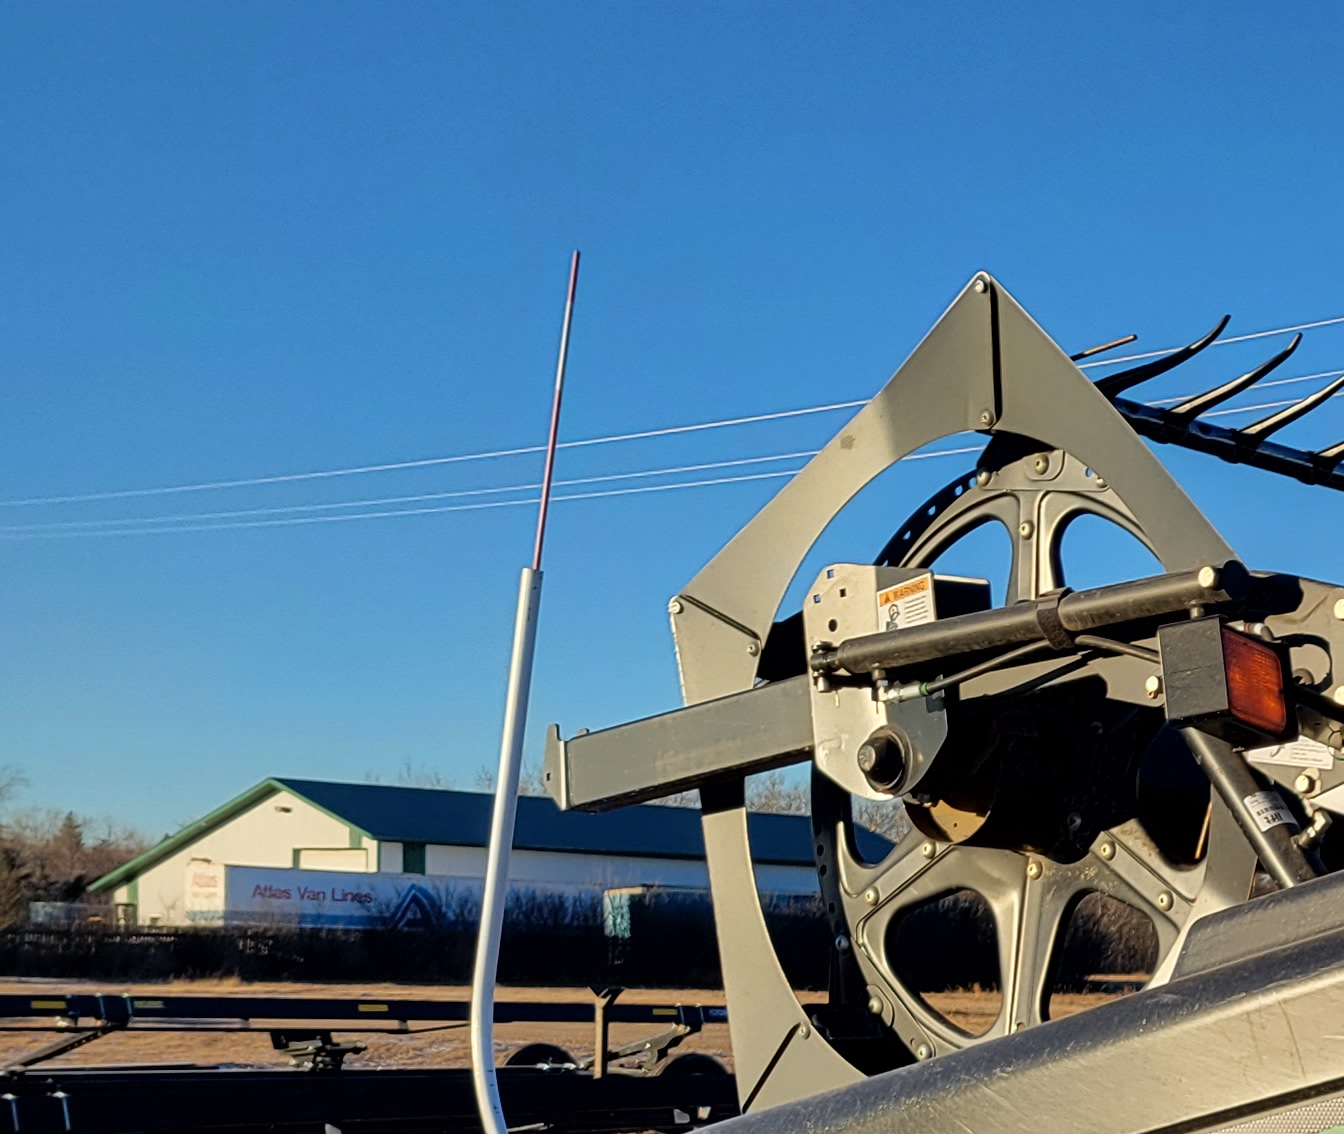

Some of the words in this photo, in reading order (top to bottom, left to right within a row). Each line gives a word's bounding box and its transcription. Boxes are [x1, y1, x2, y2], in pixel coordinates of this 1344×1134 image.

[252, 884, 292, 900] Atlas
[297, 886, 326, 901] Van
[332, 888, 373, 904] Lines
